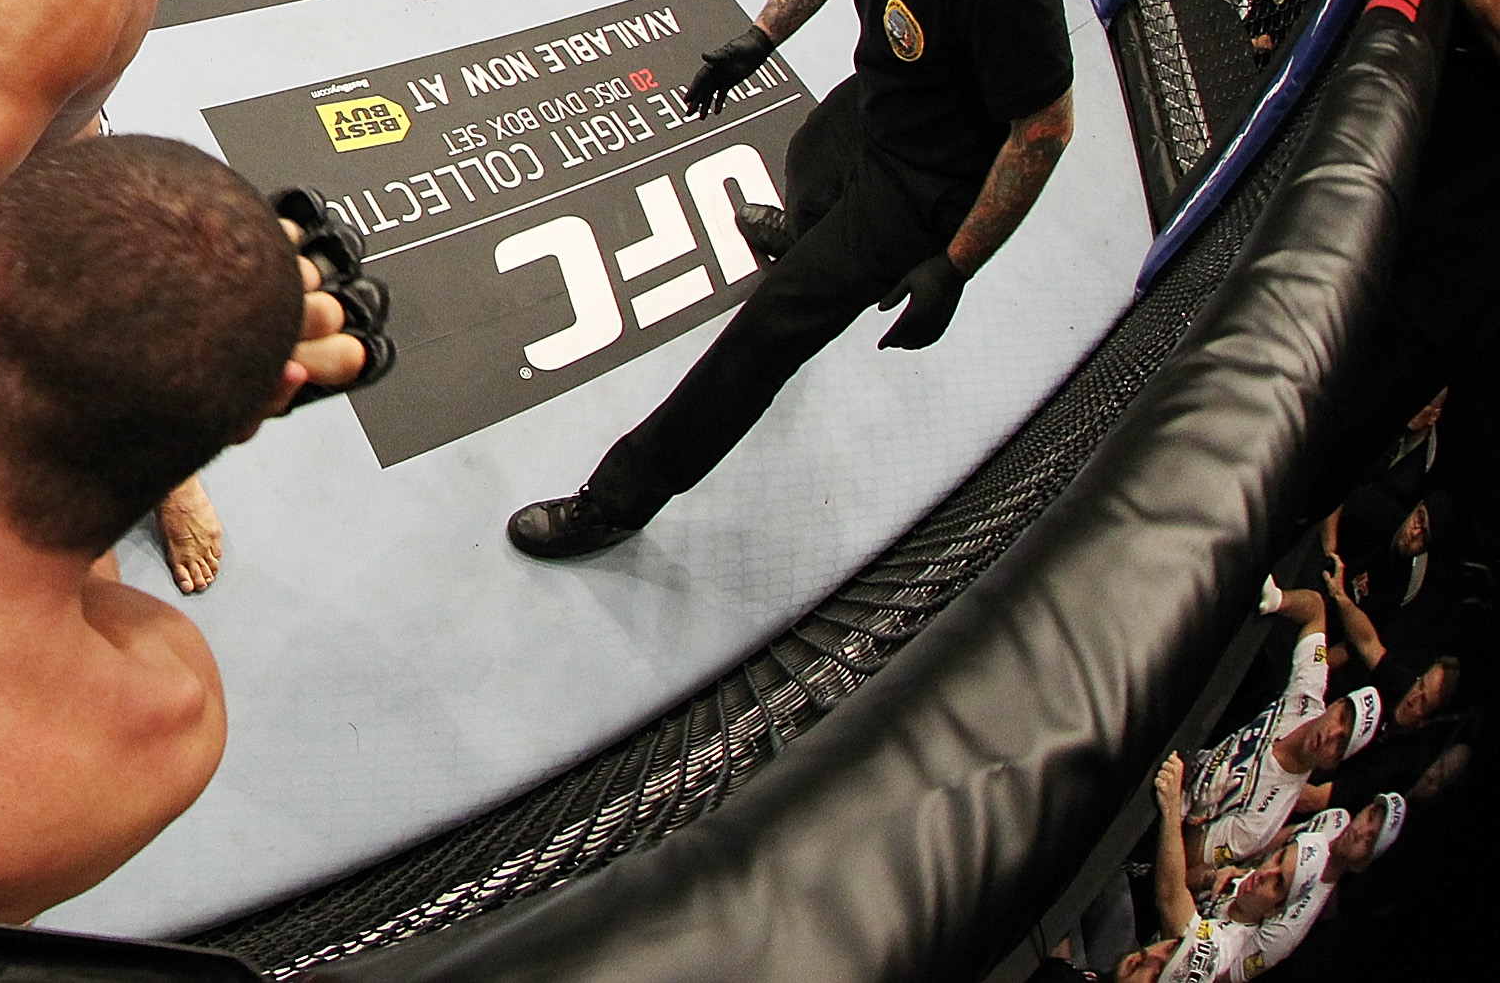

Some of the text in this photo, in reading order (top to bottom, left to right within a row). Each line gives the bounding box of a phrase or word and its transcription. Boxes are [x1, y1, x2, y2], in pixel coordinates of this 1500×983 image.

[406, 6, 681, 113] AVAILABLE NOW AT
[334, 103, 391, 126] BUY
[334, 117, 402, 142] BEST
[441, 68, 659, 156] 20 DISC DVD BOX SET
[550, 103, 655, 169] FIGHT
[494, 143, 786, 371] UFC
